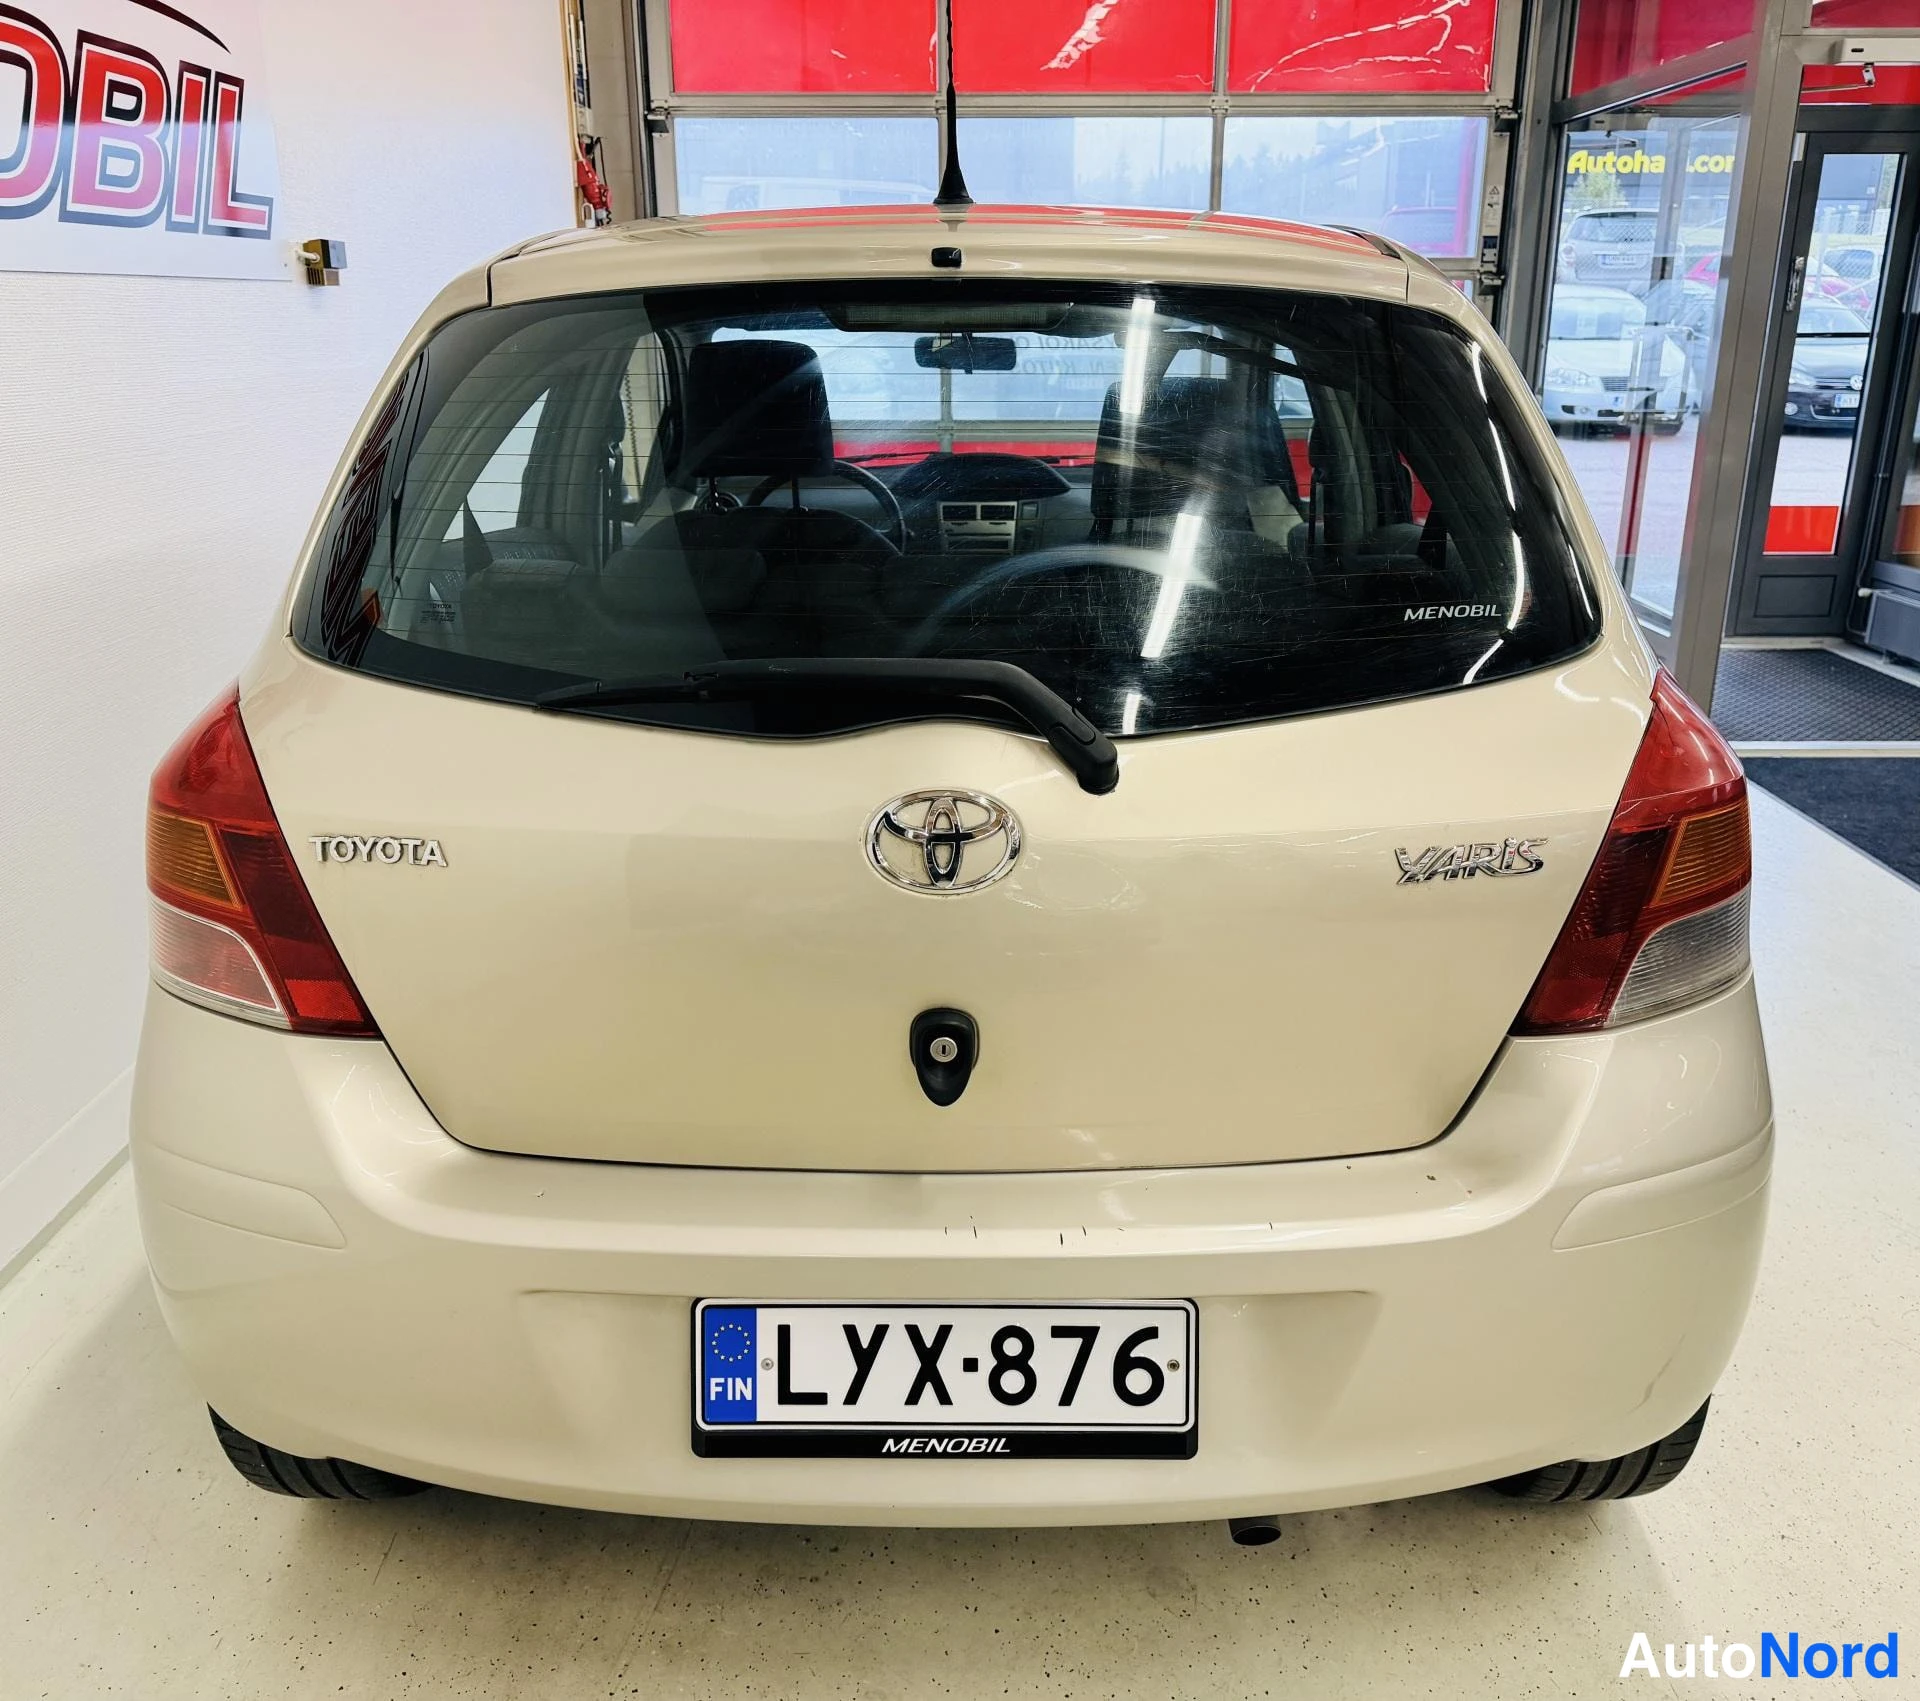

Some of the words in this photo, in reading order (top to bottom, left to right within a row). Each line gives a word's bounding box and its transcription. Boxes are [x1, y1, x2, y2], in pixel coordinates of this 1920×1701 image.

[1403, 604, 1502, 621] MENOBIL
[308, 835, 448, 867] TOYOTA
[776, 1323, 1165, 1407] LYX-876
[709, 1377, 754, 1402] FIN
[881, 1437, 1011, 1454] MENOBIL
